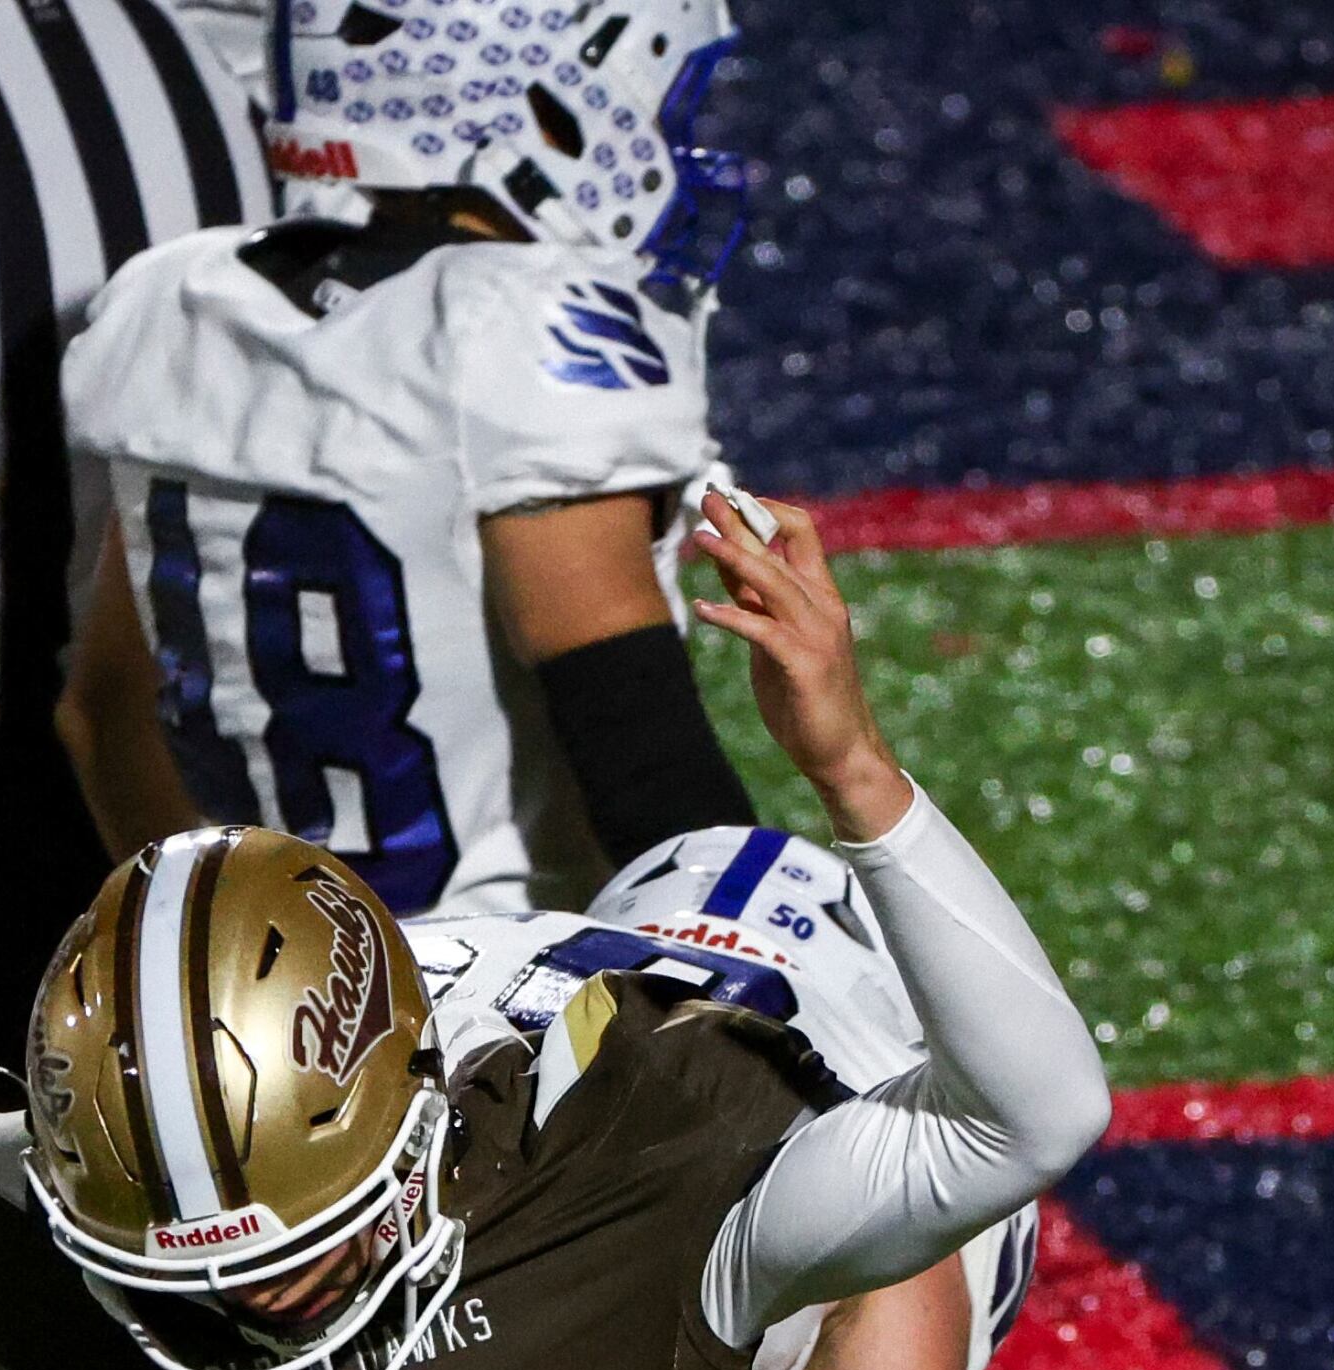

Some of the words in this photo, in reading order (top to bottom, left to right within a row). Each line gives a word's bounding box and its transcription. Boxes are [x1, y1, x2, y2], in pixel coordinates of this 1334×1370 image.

[146, 476, 461, 917] 18
[291, 878, 391, 1086] Hawks
[768, 904, 815, 940] 50
[155, 1214, 261, 1250] Riddell
